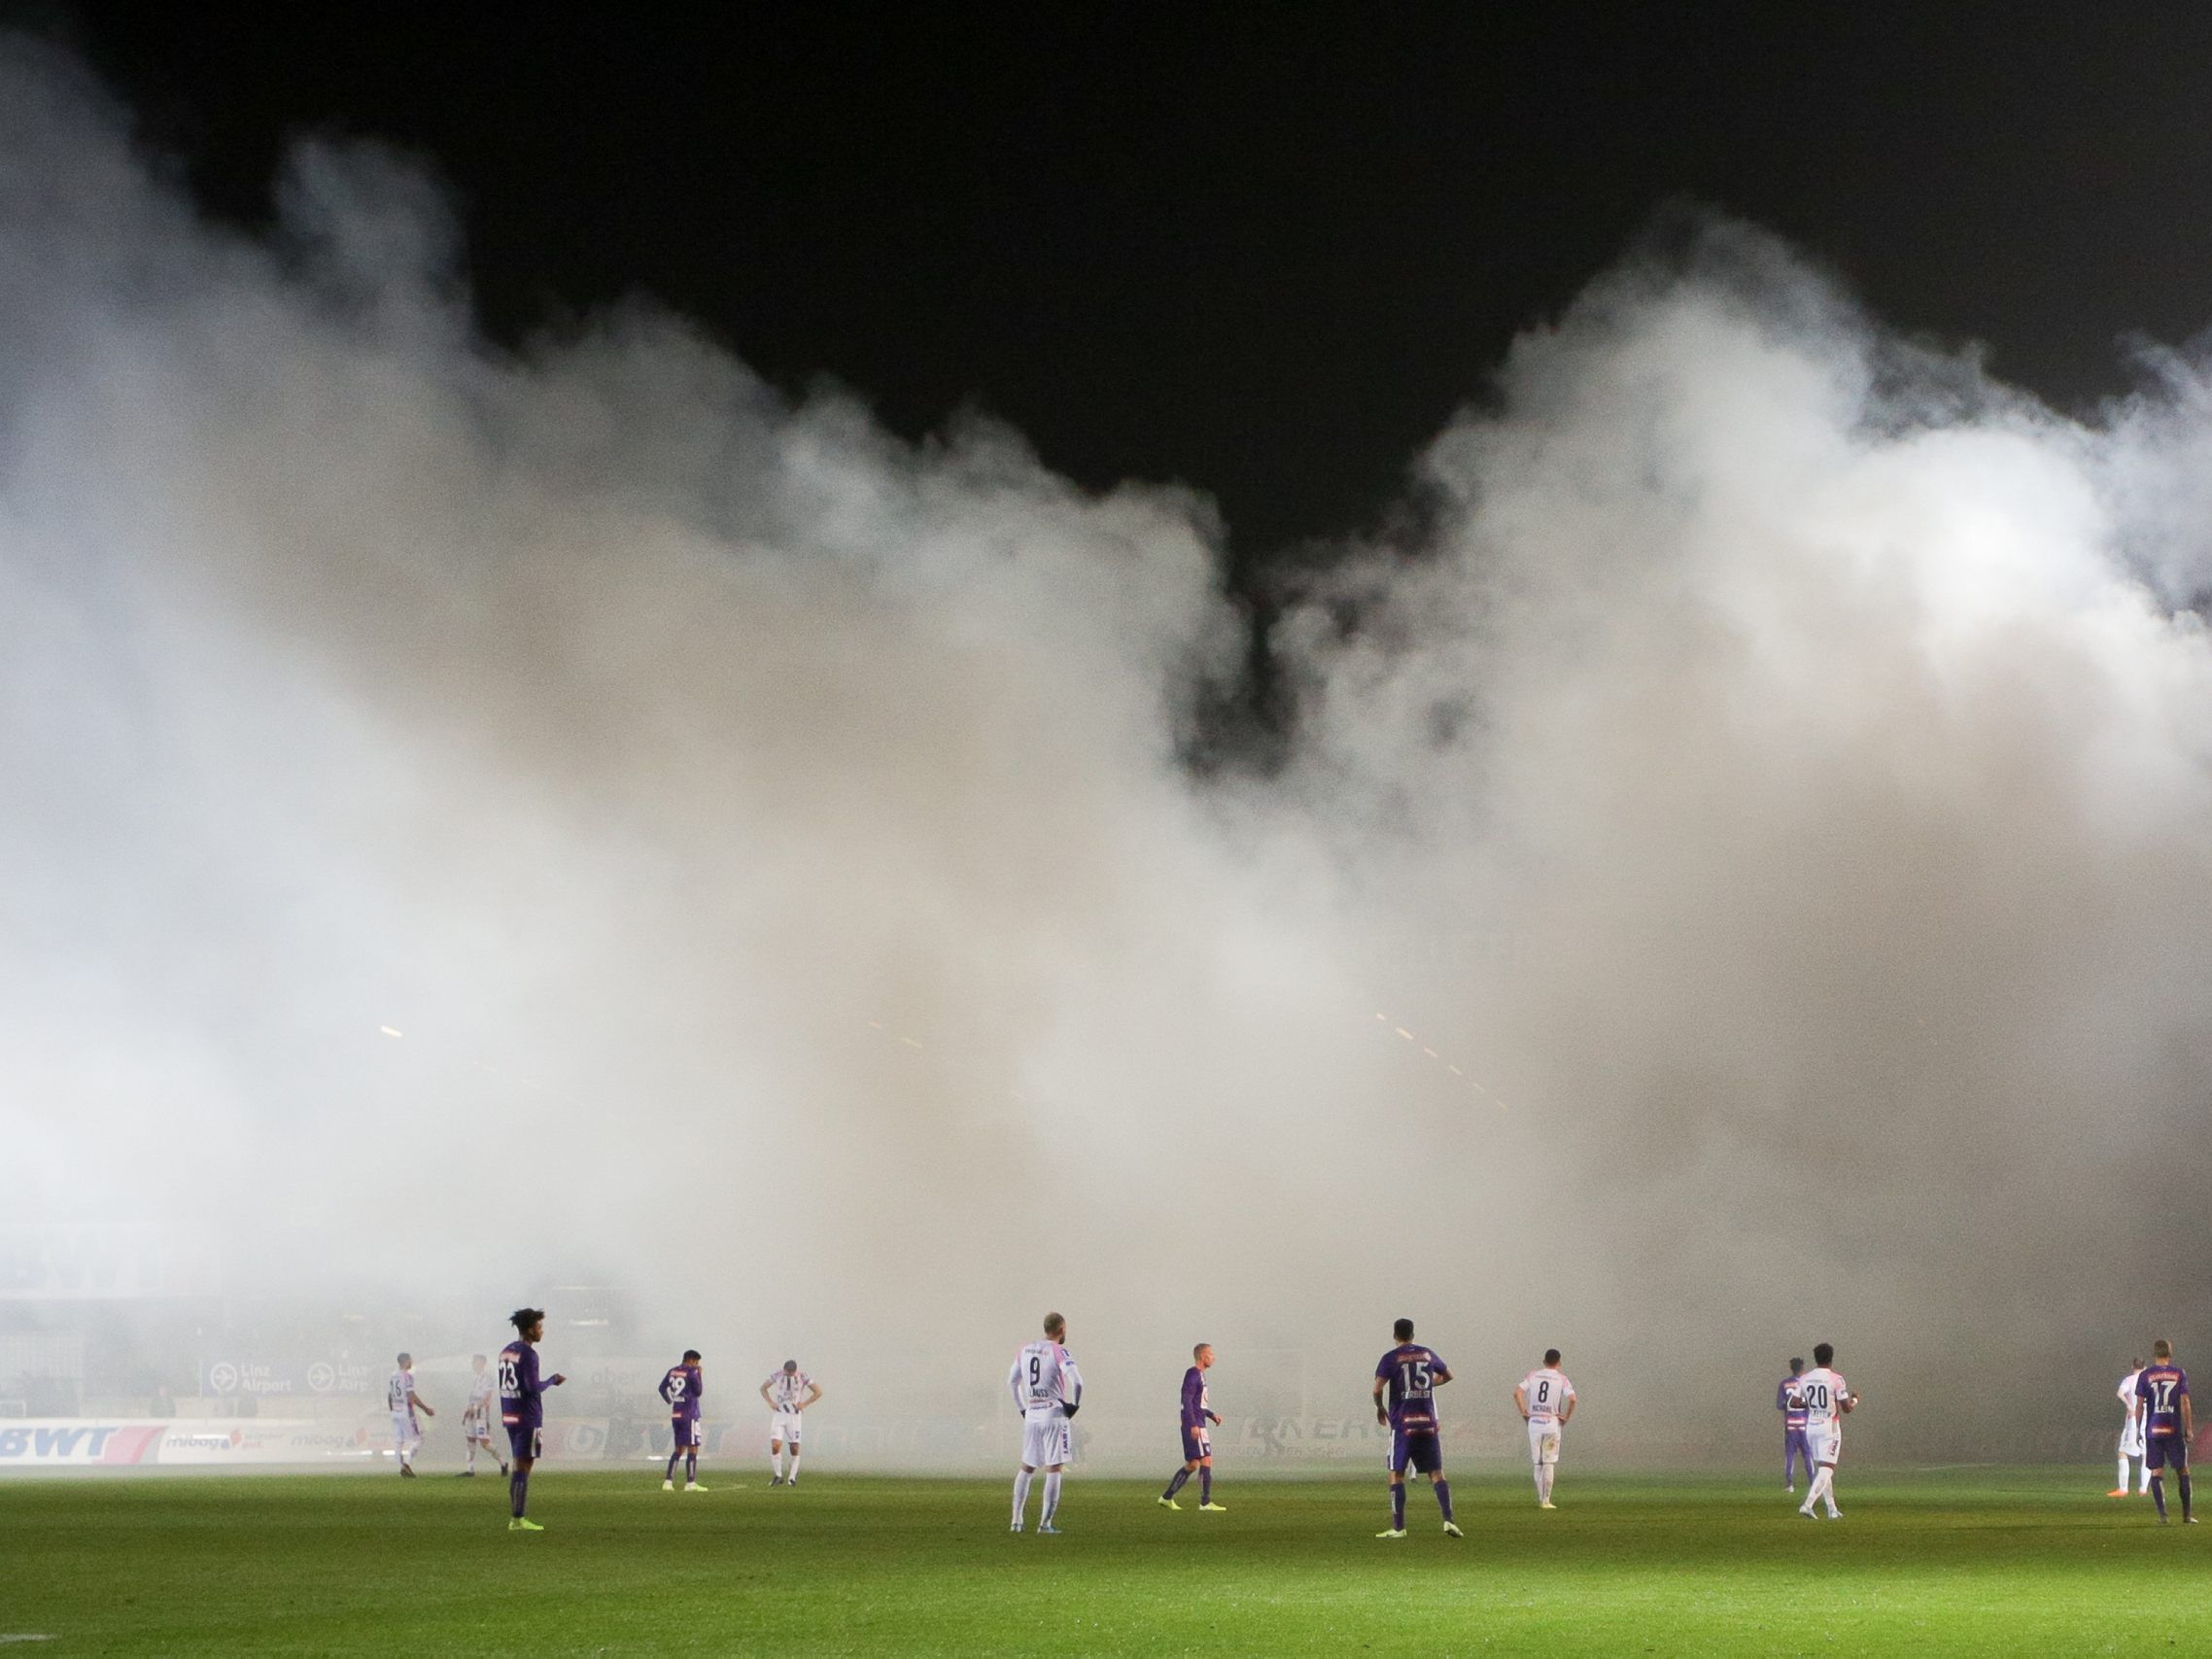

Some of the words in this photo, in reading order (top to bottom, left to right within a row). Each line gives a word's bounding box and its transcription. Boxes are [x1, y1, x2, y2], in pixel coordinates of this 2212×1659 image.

[242, 1363, 270, 1376] Linz
[499, 1362, 518, 1391] 23
[1030, 1357, 1040, 1386] 9
[1401, 1362, 1431, 1390] 15
[242, 1378, 292, 1394] Airport
[670, 1376, 685, 1397] 29
[1538, 1380, 1549, 1402] 8
[1807, 1385, 1828, 1408] 20
[2151, 1381, 2177, 1406] 17
[0, 1428, 118, 1457] BWT
